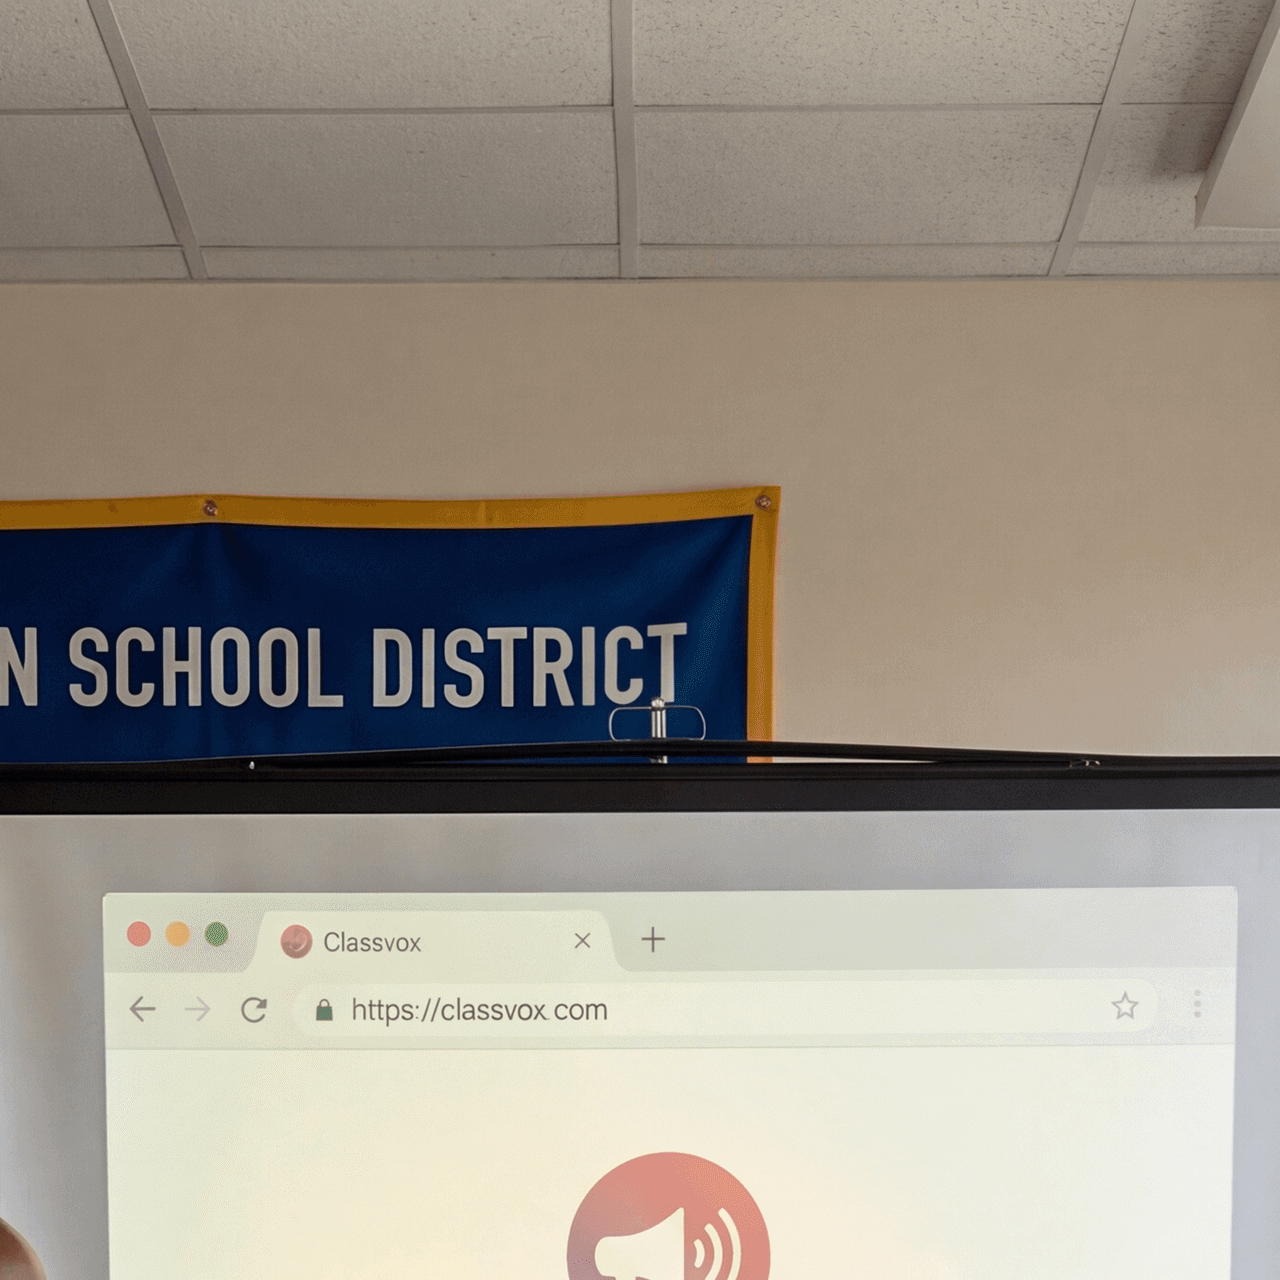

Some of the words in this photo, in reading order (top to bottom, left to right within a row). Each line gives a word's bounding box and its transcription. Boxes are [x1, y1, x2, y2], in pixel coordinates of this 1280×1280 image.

[68, 626, 344, 708] SCHOOL
[372, 621, 688, 708] DISTRICT
[324, 931, 422, 953] Classvox
[352, 997, 608, 1026] https://classvox.com
